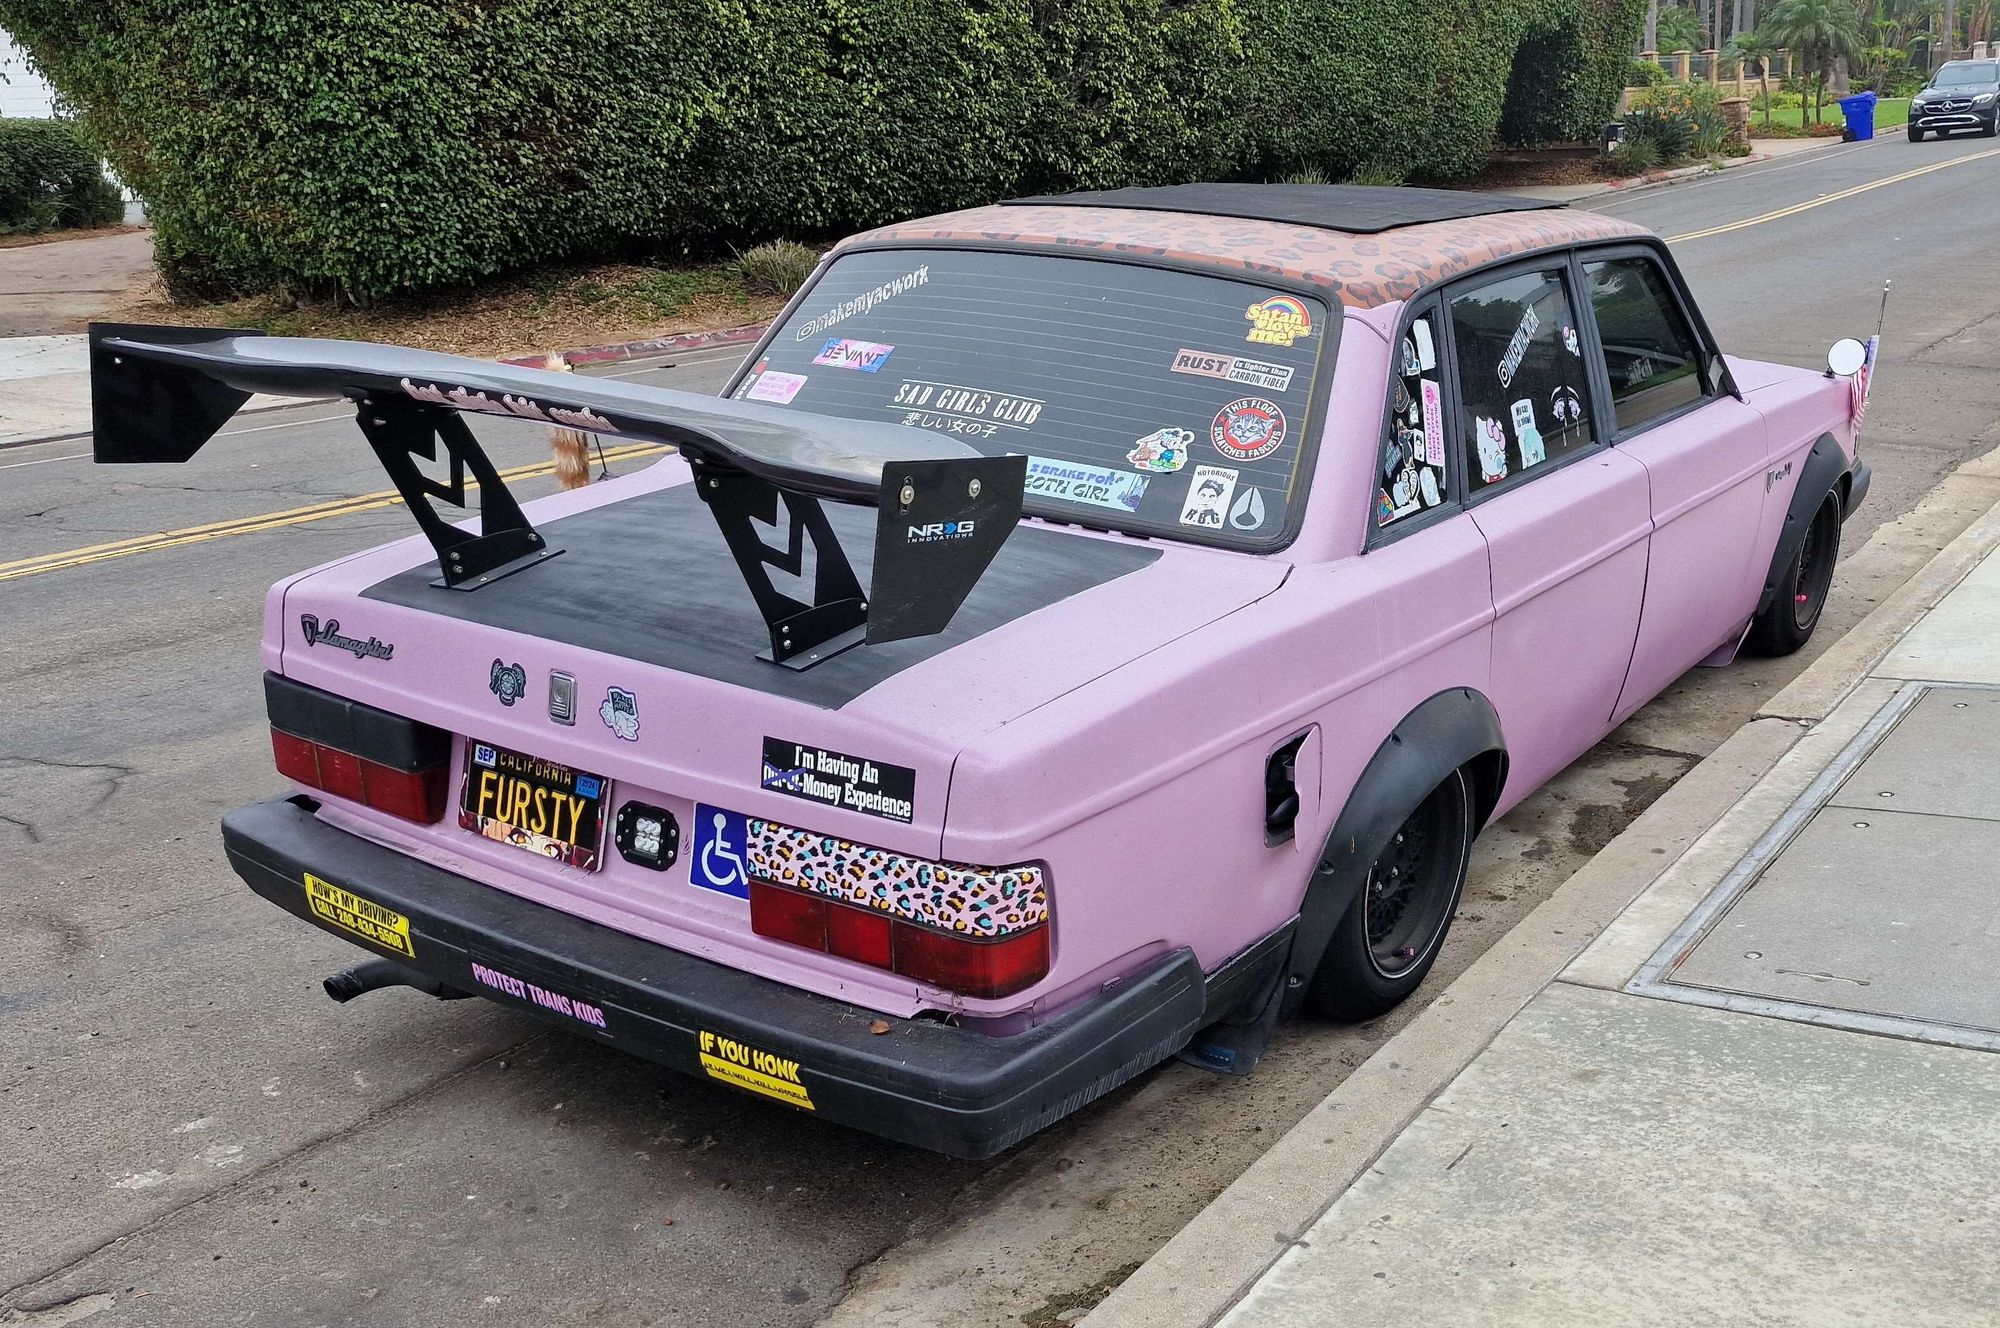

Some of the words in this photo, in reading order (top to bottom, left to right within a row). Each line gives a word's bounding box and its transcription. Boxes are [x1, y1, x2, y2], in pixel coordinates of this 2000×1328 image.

[815, 264, 929, 333] makemyacwork
[1247, 305, 1303, 324] Satan
[1249, 329, 1296, 346] me!
[1266, 320, 1311, 335] loves
[822, 344, 884, 367] DEVIANT
[1177, 355, 1228, 373] RUST
[1229, 369, 1262, 384] CARBON
[1262, 377, 1286, 389] FIBER
[1235, 360, 1243, 368] is
[1244, 362, 1270, 374] lighter
[1270, 367, 1288, 377] than
[894, 383, 934, 407] SAD
[993, 398, 1042, 425] CLUB
[1226, 400, 1248, 415] THIS
[1251, 400, 1278, 417] FLOOF
[901, 411, 998, 439] 悲しい女の子
[1214, 426, 1246, 458] SCRATCHES
[1248, 430, 1281, 458] FASCISTS
[1030, 464, 1038, 473] I
[1040, 464, 1085, 480] BRAKE
[1086, 473, 1114, 486] FOR
[1197, 469, 1236, 481] NOTORIOUS
[1024, 474, 1070, 495] GOTH
[1072, 483, 1110, 502] GIRL
[907, 532, 974, 544] INNOVATIONS
[477, 747, 494, 763] SEP
[794, 745, 814, 769] I'm
[816, 750, 860, 784] Having
[861, 761, 879, 784] An
[500, 753, 572, 786] CALIFORNIA
[580, 778, 595, 789] 2024
[478, 770, 586, 846] FURSTY
[844, 782, 911, 817] Experience
[312, 879, 339, 903] HOW'S
[341, 893, 355, 911] MY
[357, 900, 399, 928] DRIVING?
[314, 898, 338, 920] CALL
[471, 962, 527, 1000] PROTECT
[527, 983, 573, 1016] TRANS
[572, 1000, 606, 1028] KIDS
[700, 1030, 714, 1052] IF
[717, 1036, 750, 1066] YOU
[753, 1050, 801, 1083] HONK
